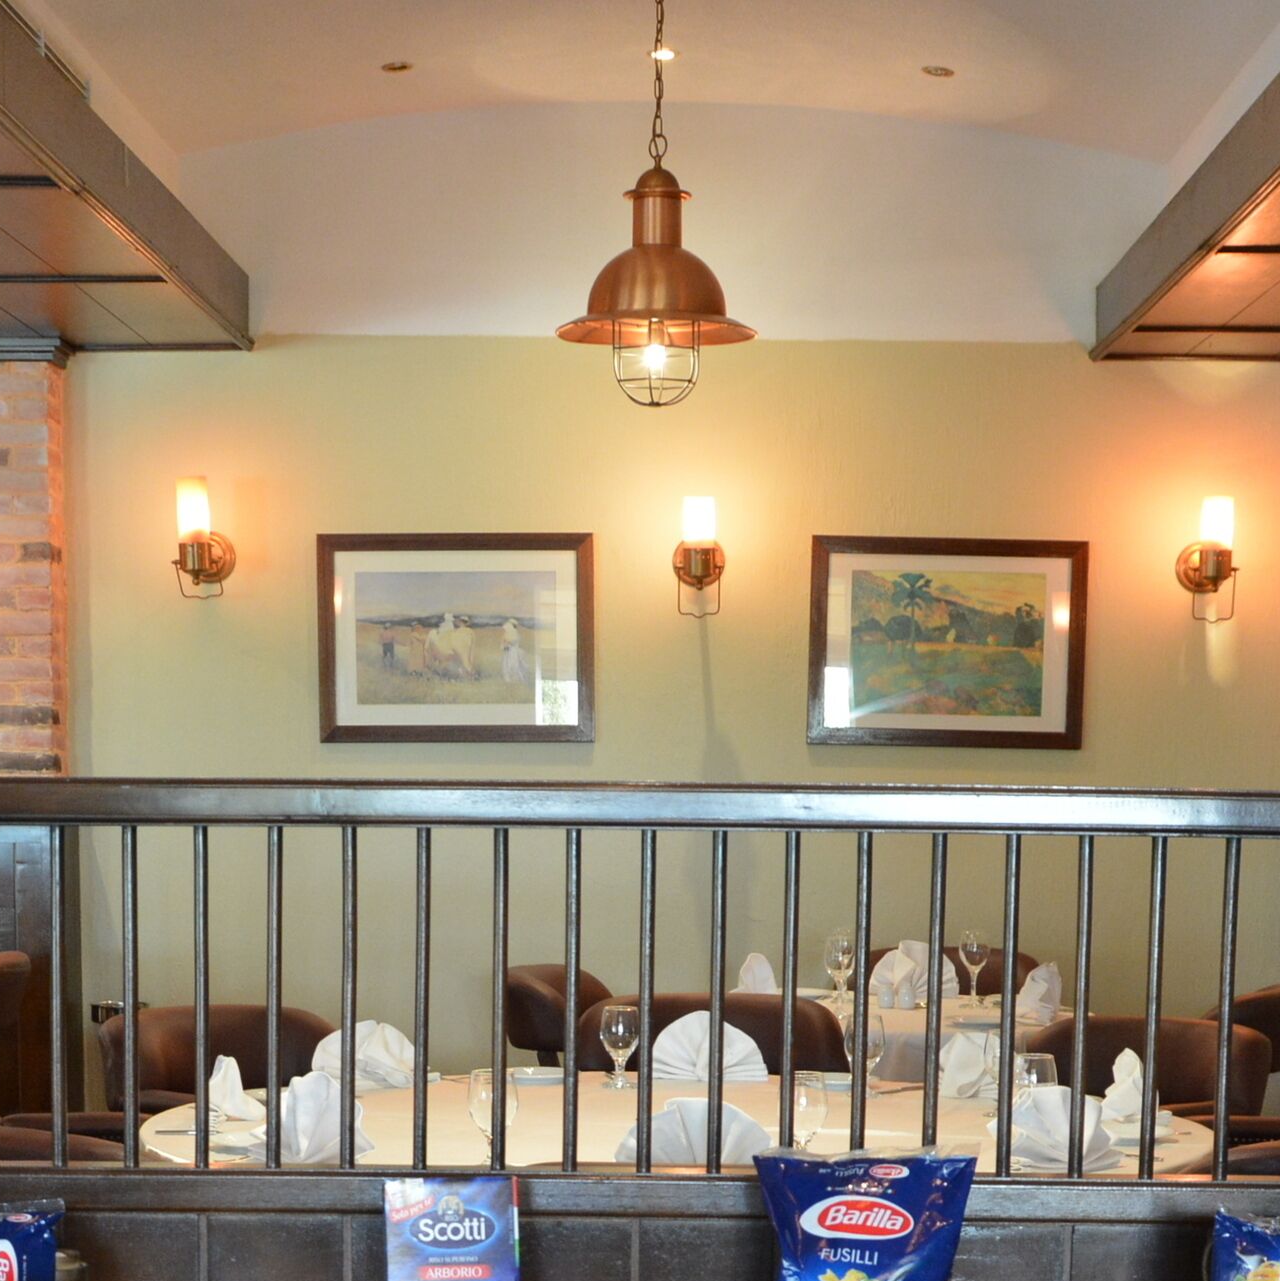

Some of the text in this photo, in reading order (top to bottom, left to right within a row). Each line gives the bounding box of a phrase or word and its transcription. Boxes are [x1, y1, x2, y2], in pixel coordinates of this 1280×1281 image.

[825, 1205, 904, 1231] Barilla
[418, 1218, 486, 1242] Scotti
[820, 1247, 879, 1266] FUSILLI
[427, 1266, 482, 1279] ARBORIO
